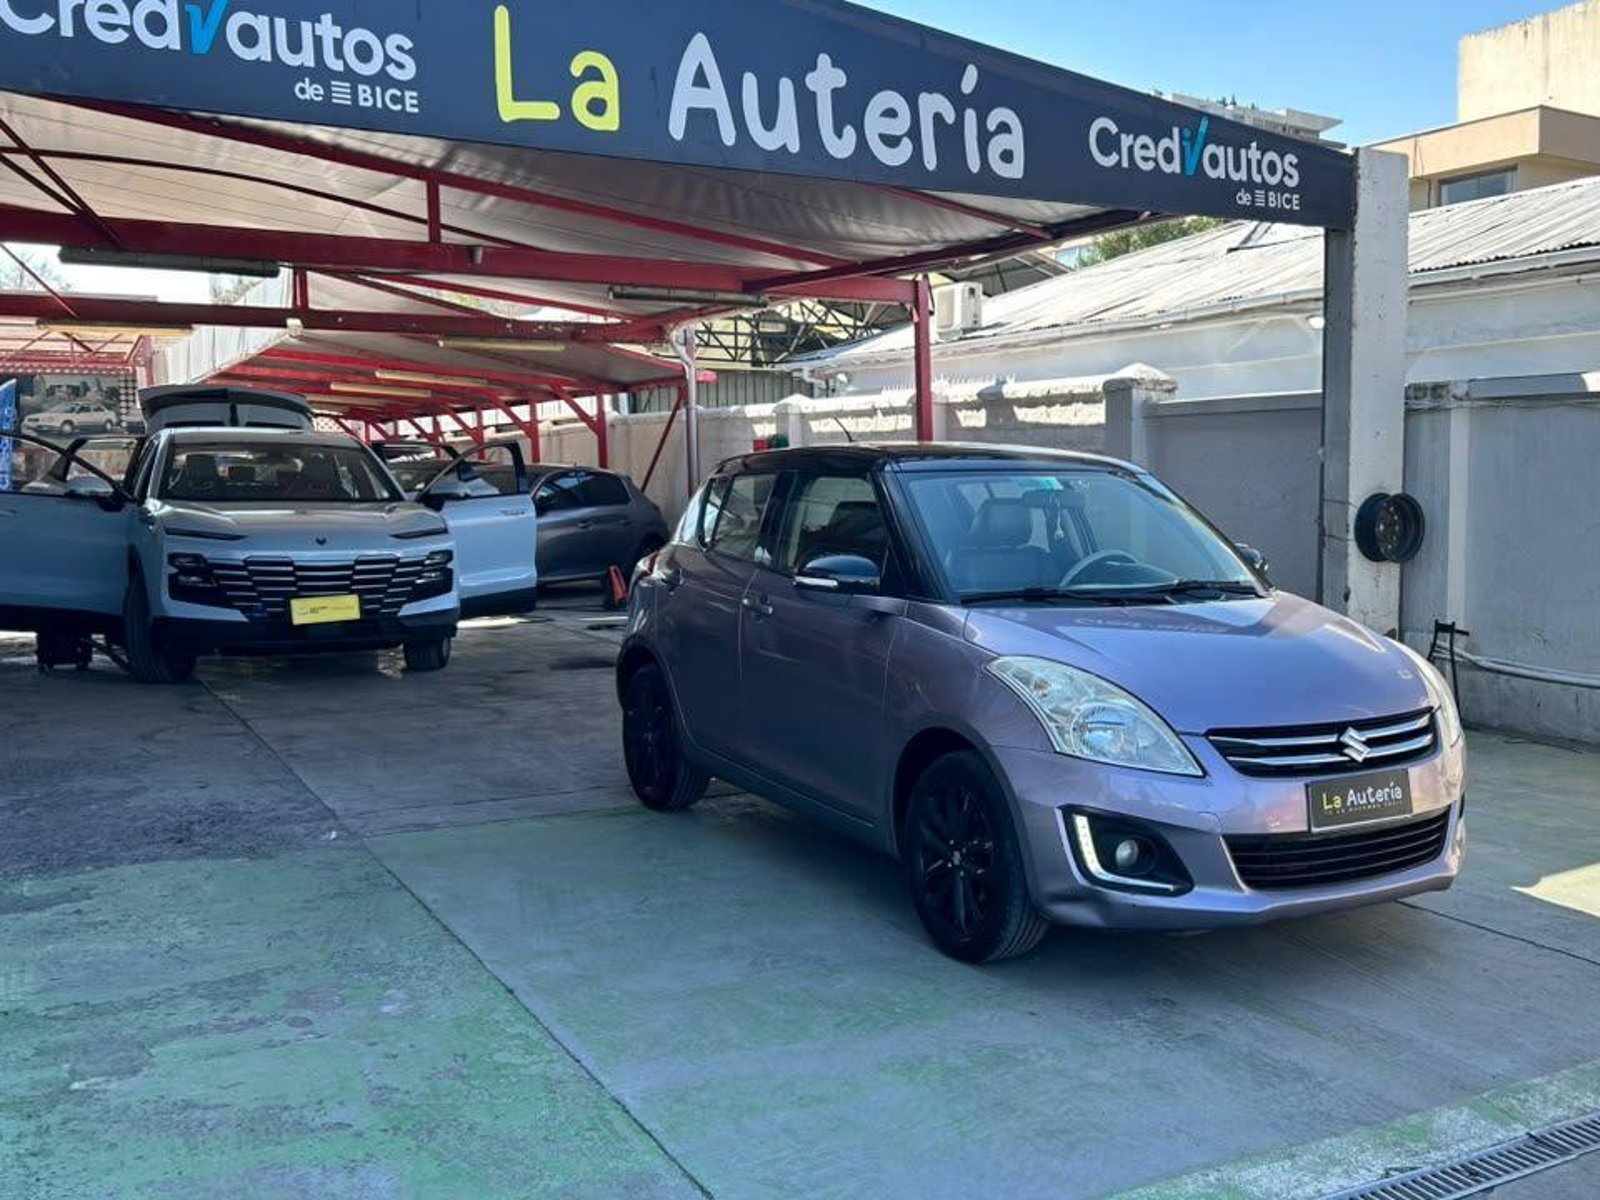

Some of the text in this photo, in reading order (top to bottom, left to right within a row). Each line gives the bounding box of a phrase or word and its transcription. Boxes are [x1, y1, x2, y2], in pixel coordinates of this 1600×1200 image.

[294, 77, 420, 113] de BICE
[494, 5, 1025, 180] La Autería
[1236, 188, 1301, 211] de BICE
[1322, 792, 1342, 811] La
[1347, 781, 1403, 806] Autería
